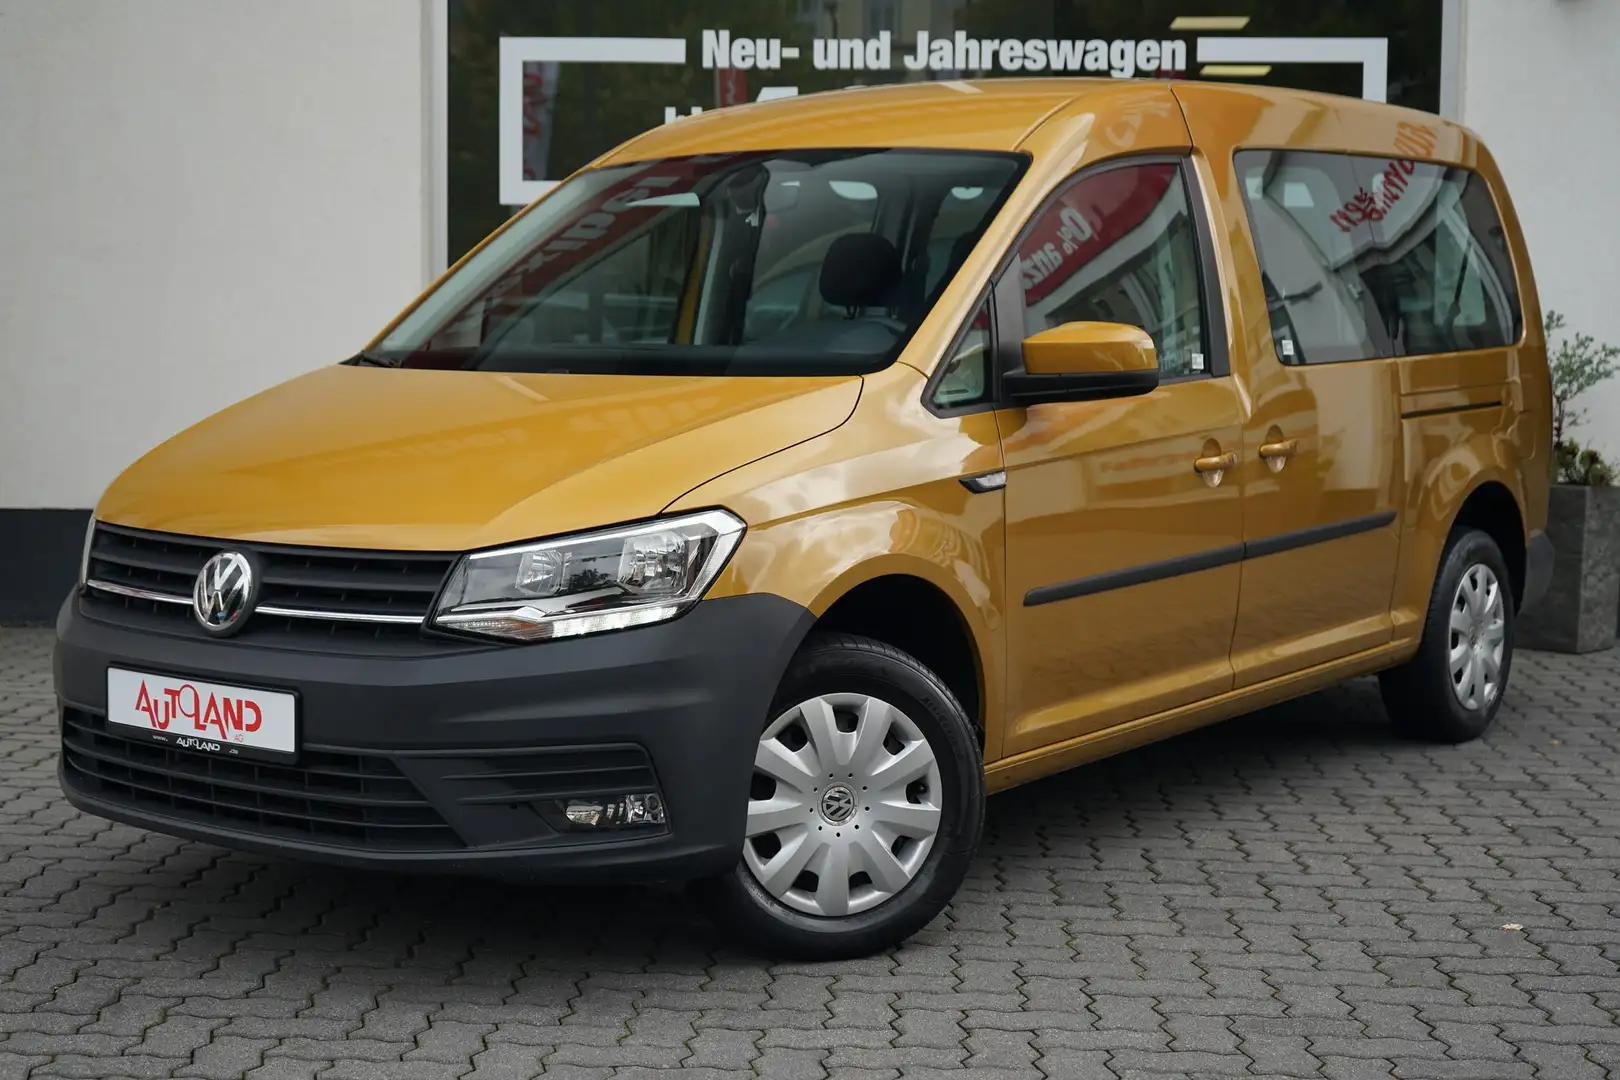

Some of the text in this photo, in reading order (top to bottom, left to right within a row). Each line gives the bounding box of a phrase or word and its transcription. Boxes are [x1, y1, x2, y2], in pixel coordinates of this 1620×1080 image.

[703, 30, 1187, 78] Neu- und Jahreswagen
[135, 680, 262, 740] AUTOLAND
[176, 737, 221, 752] AUTOLAND
